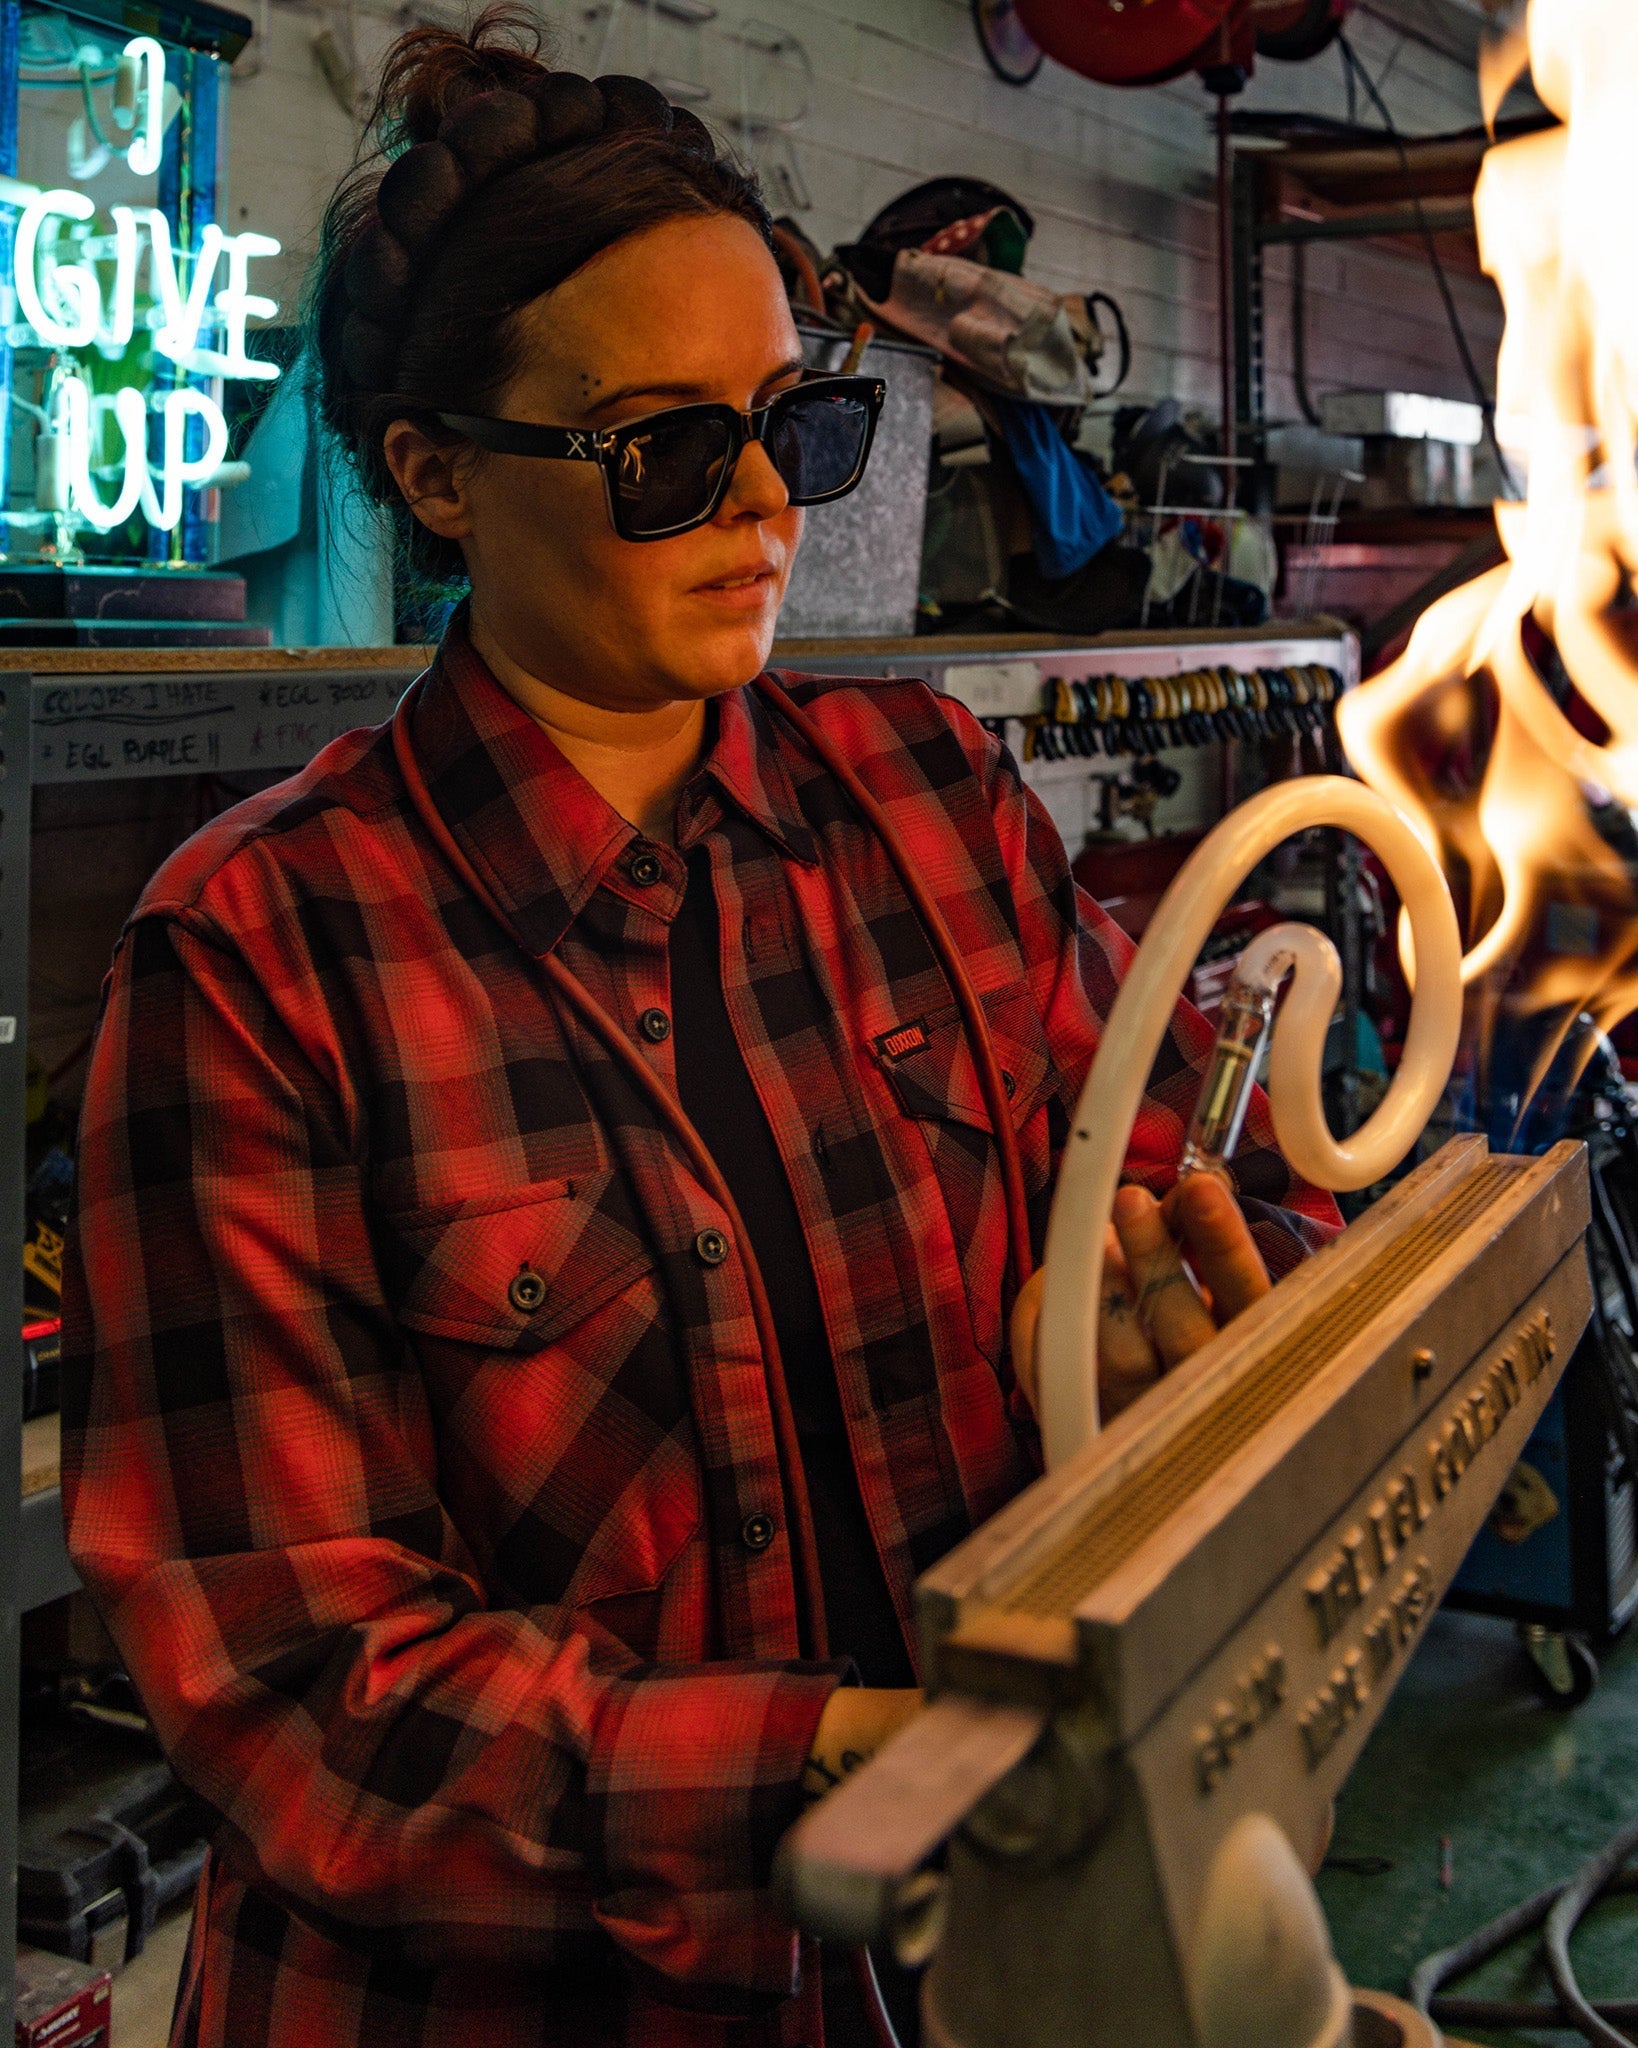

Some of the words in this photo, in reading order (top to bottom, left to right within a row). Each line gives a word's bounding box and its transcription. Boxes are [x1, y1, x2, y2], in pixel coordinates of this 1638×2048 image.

[14, 189, 281, 379] GIVE
[64, 376, 229, 531] UP
[43, 685, 135, 714] COLORS
[166, 681, 219, 706] HATE
[66, 740, 112, 769] EGL
[123, 734, 199, 765] PURPLE
[884, 1026, 926, 1057] DIXXON
